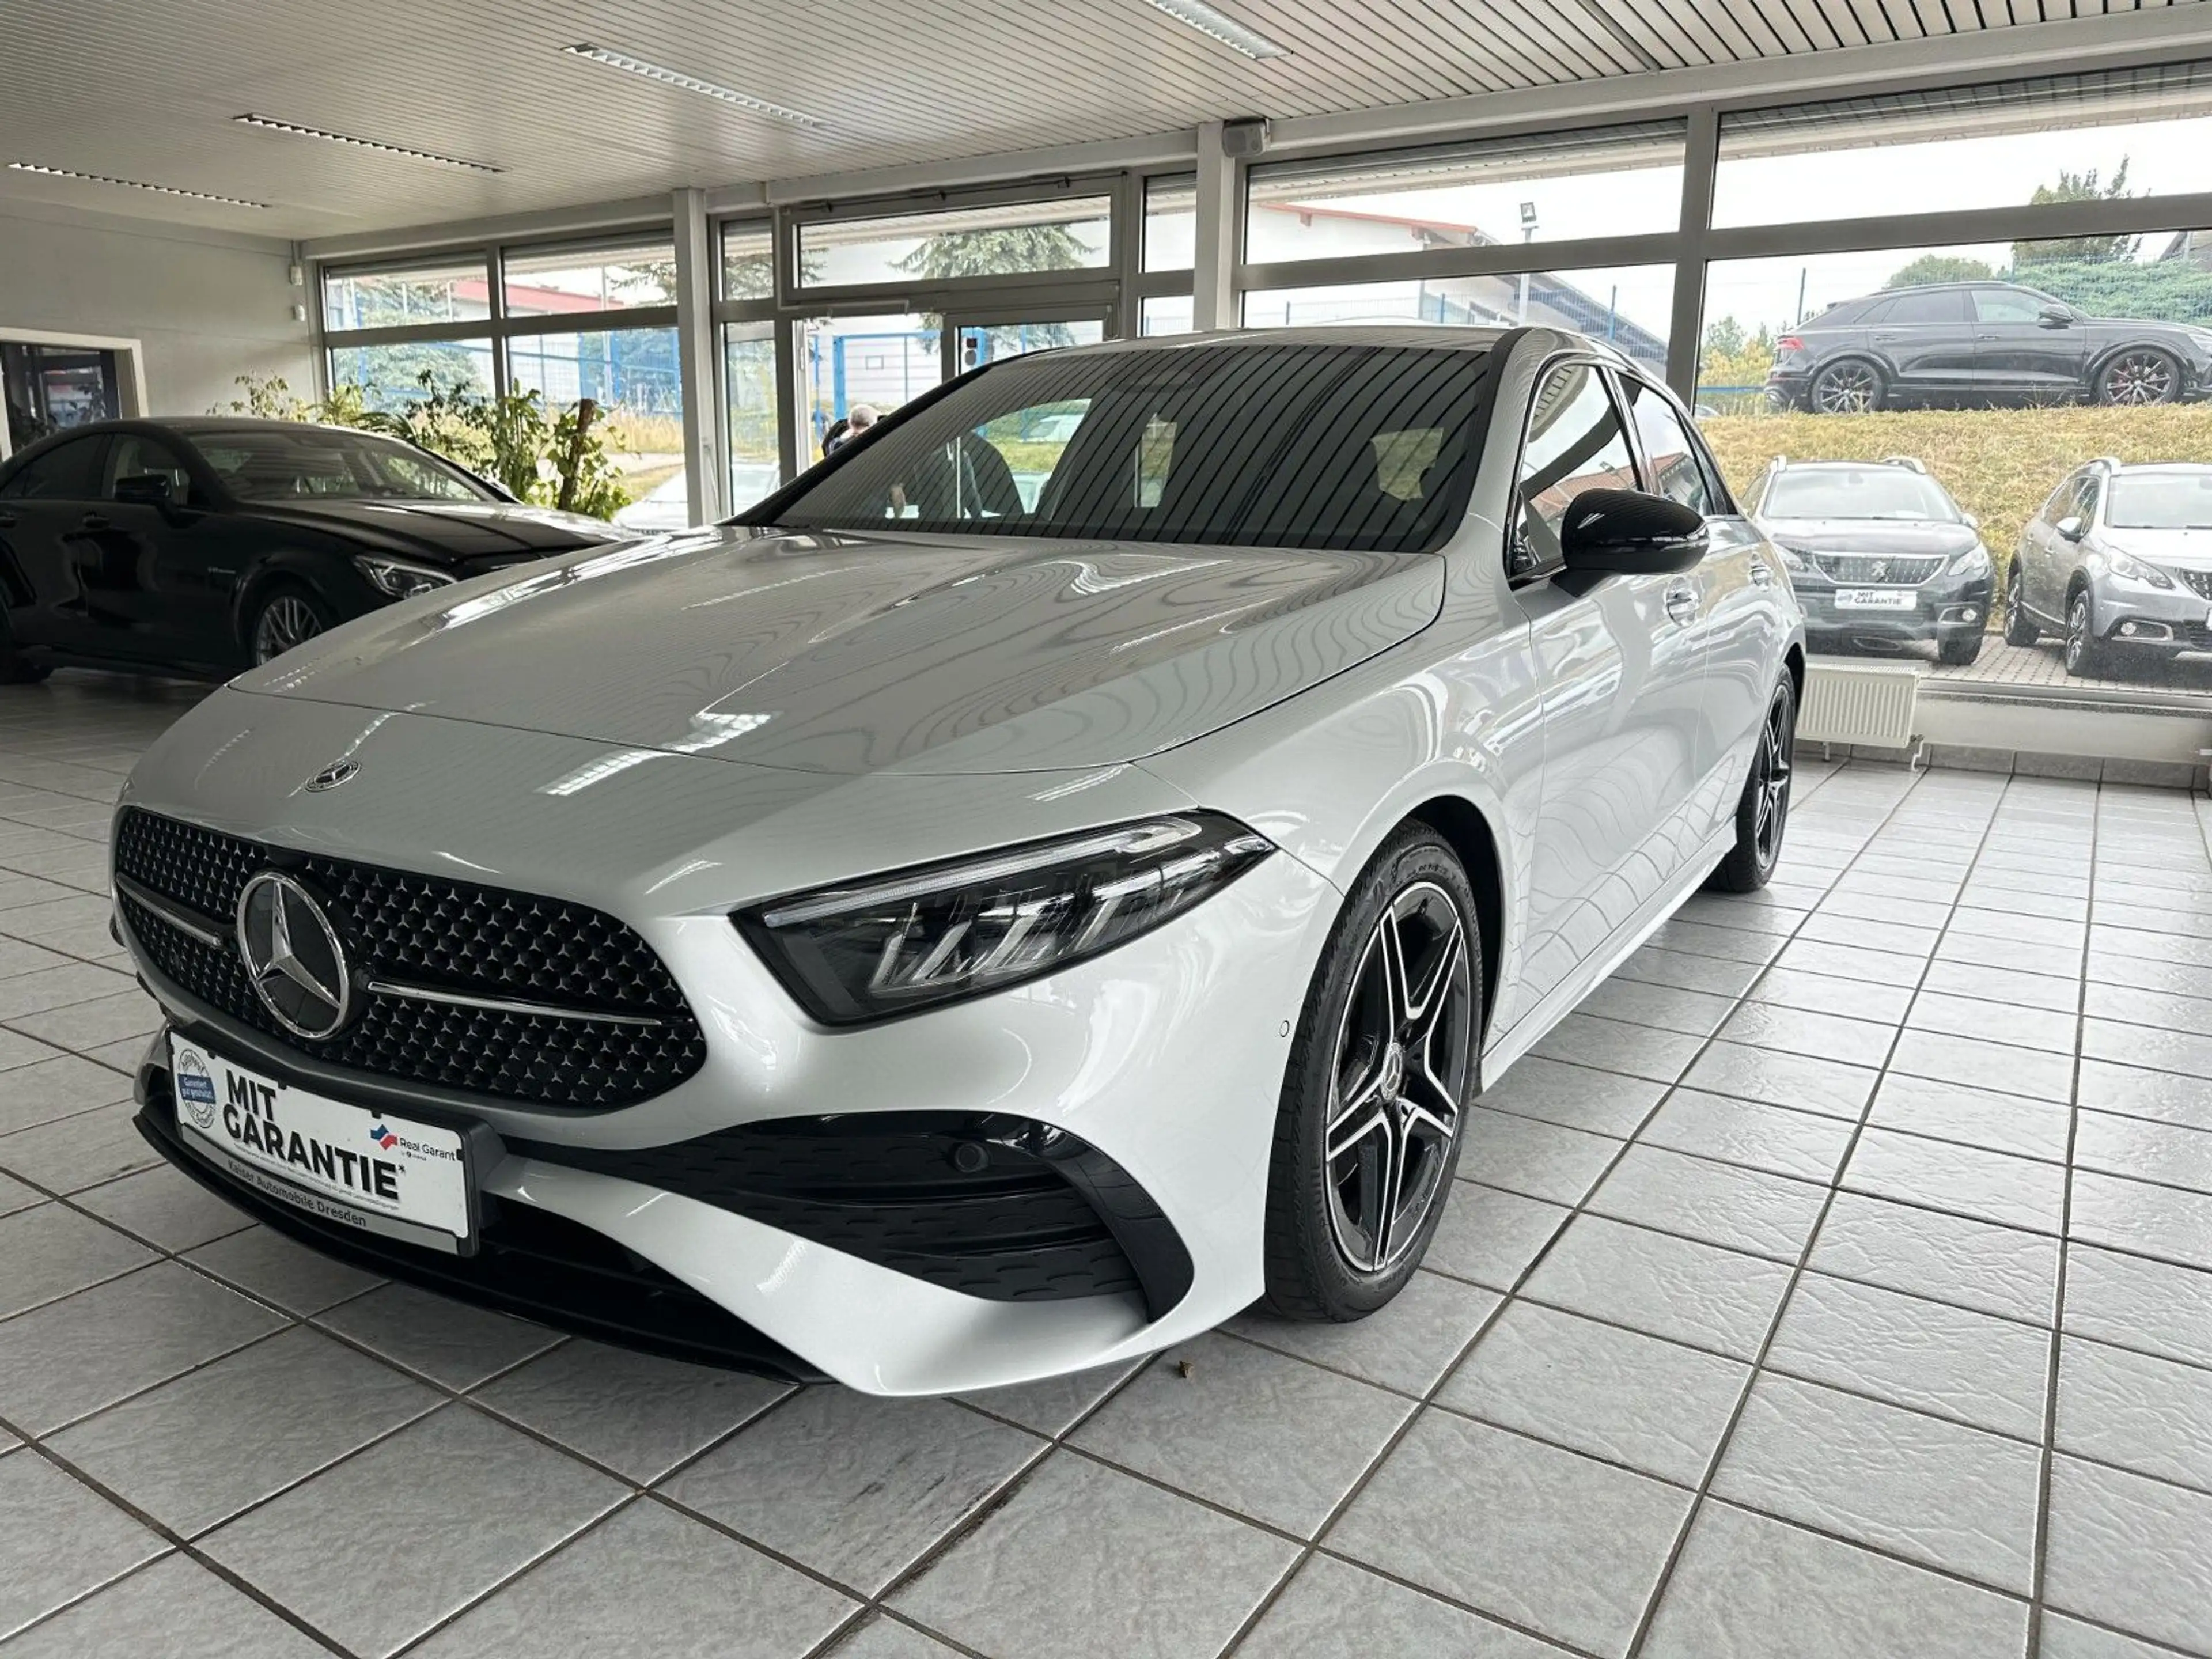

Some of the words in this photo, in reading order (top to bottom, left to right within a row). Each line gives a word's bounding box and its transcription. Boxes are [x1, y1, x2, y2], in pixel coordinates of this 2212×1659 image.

[226, 1069, 276, 1122] MIT
[399, 1137, 420, 1151] Real
[422, 1143, 456, 1161] Garant
[257, 1176, 315, 1210] Automobile
[317, 1200, 367, 1227] Dresden
